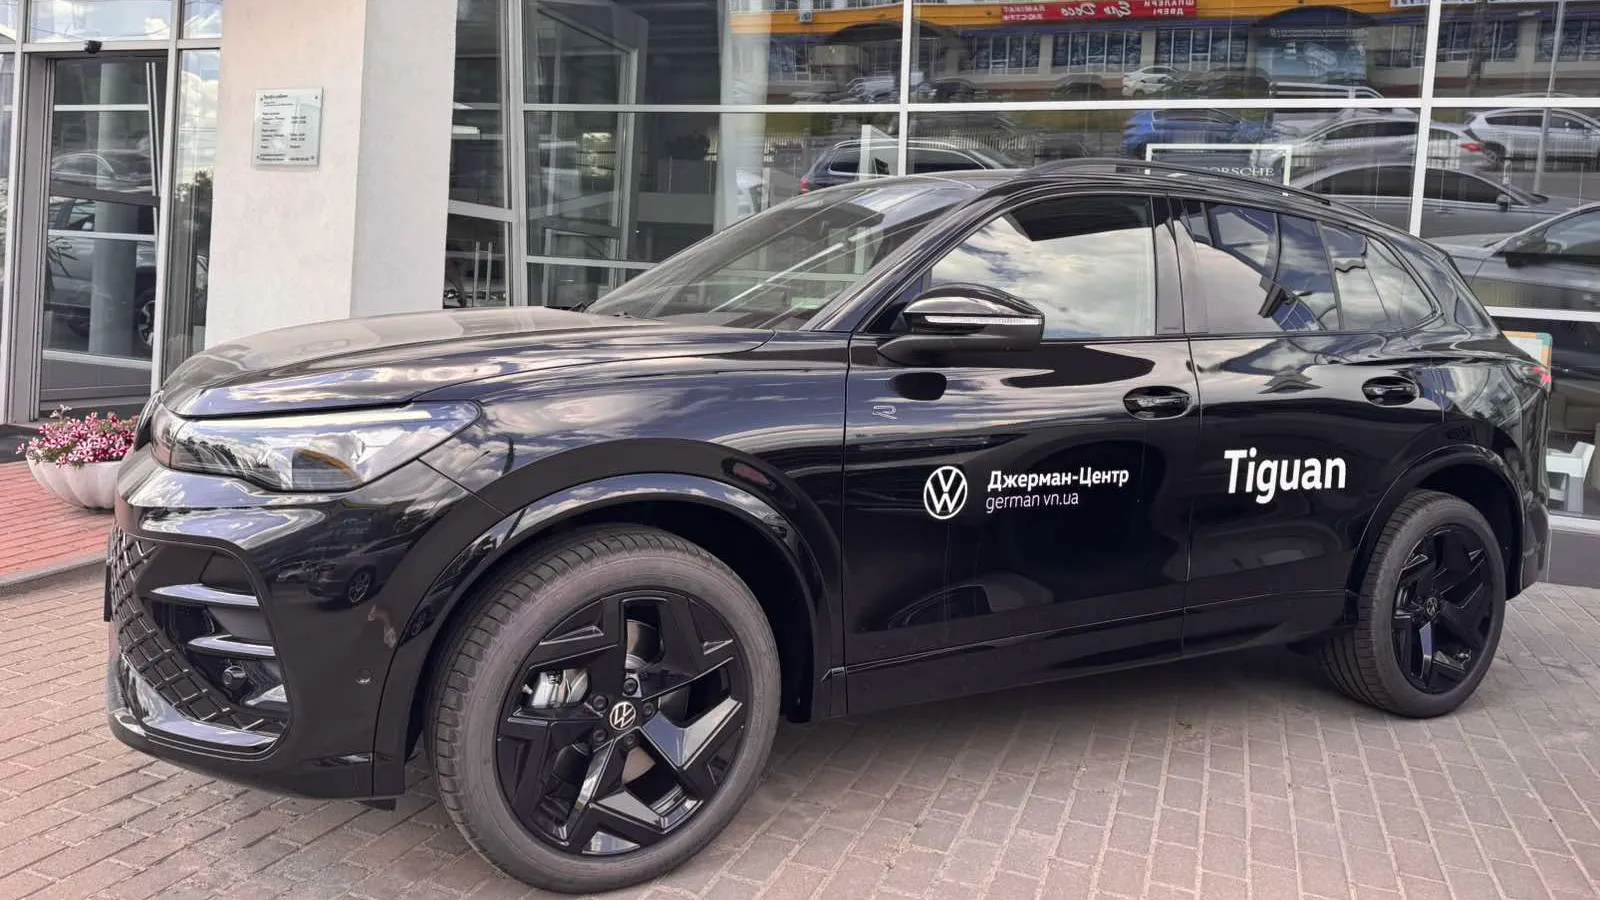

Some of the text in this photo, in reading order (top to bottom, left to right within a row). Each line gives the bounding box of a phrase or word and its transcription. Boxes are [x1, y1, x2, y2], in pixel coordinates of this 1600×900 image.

[1207, 166, 1274, 177] ORSCHE
[987, 466, 1129, 492] Джерман-Центр
[1224, 447, 1347, 504] Tiguan
[985, 494, 1041, 513] german
